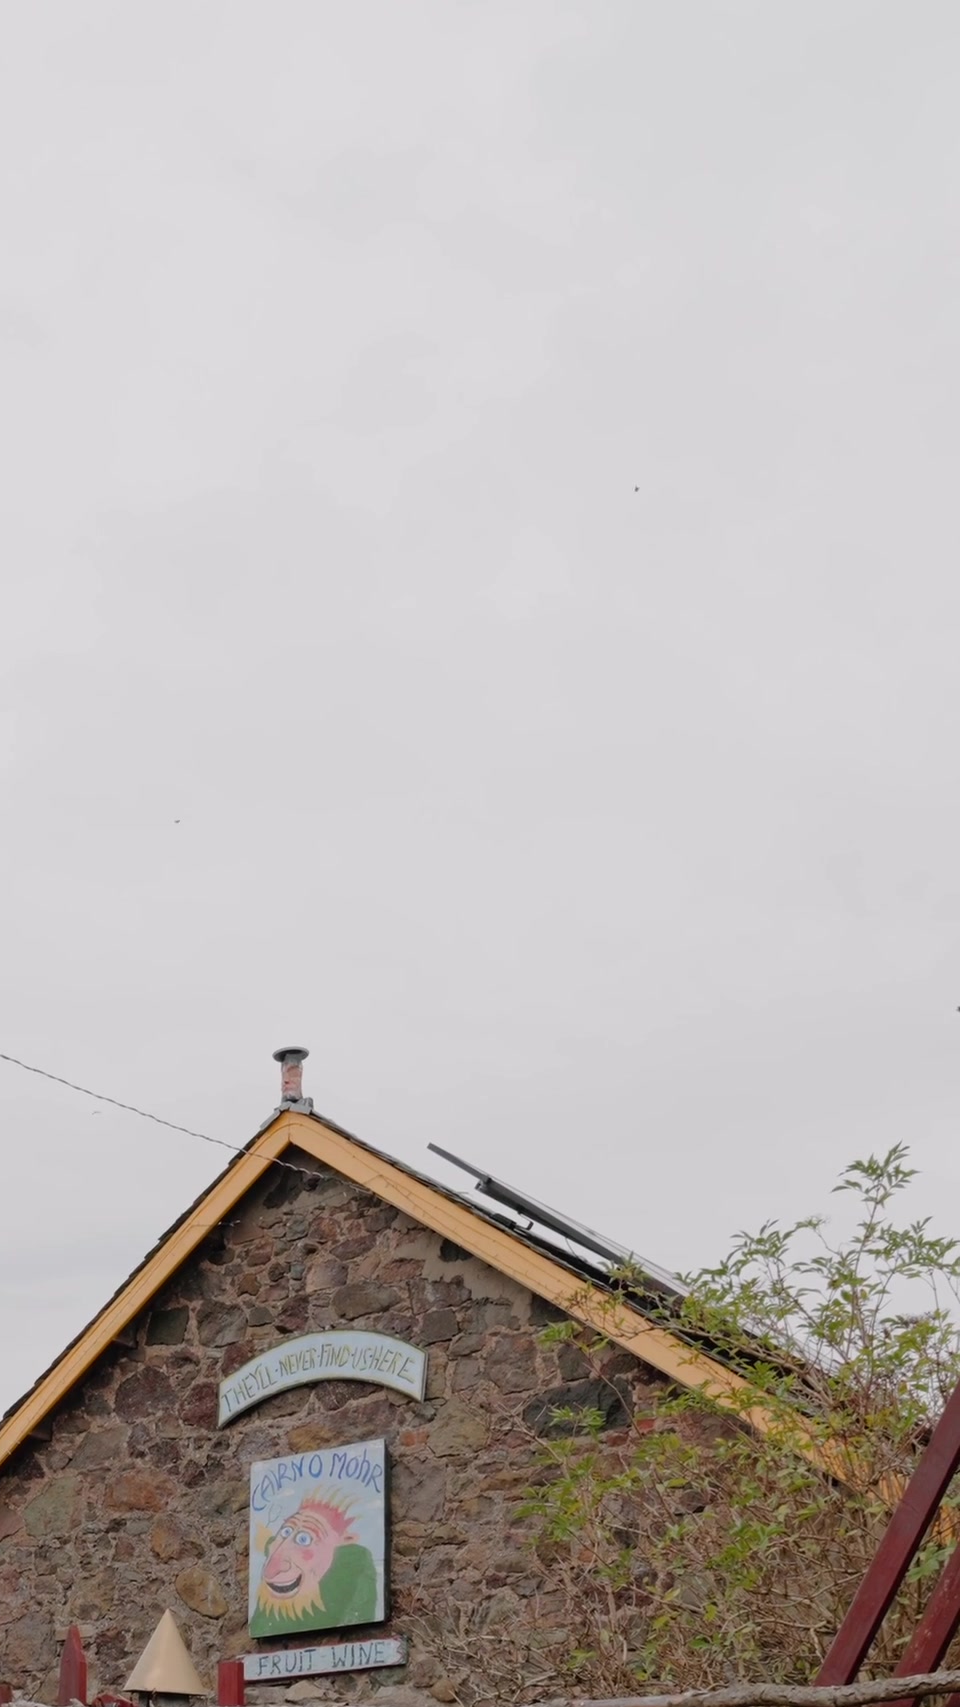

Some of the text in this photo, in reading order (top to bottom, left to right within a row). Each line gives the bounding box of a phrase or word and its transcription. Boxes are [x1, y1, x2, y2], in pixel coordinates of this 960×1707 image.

[278, 1348, 316, 1378] NEVER
[351, 1348, 369, 1372] US
[369, 1344, 417, 1385] HERE
[251, 1456, 305, 1512] CAIRN
[331, 1641, 386, 1669] WINE
